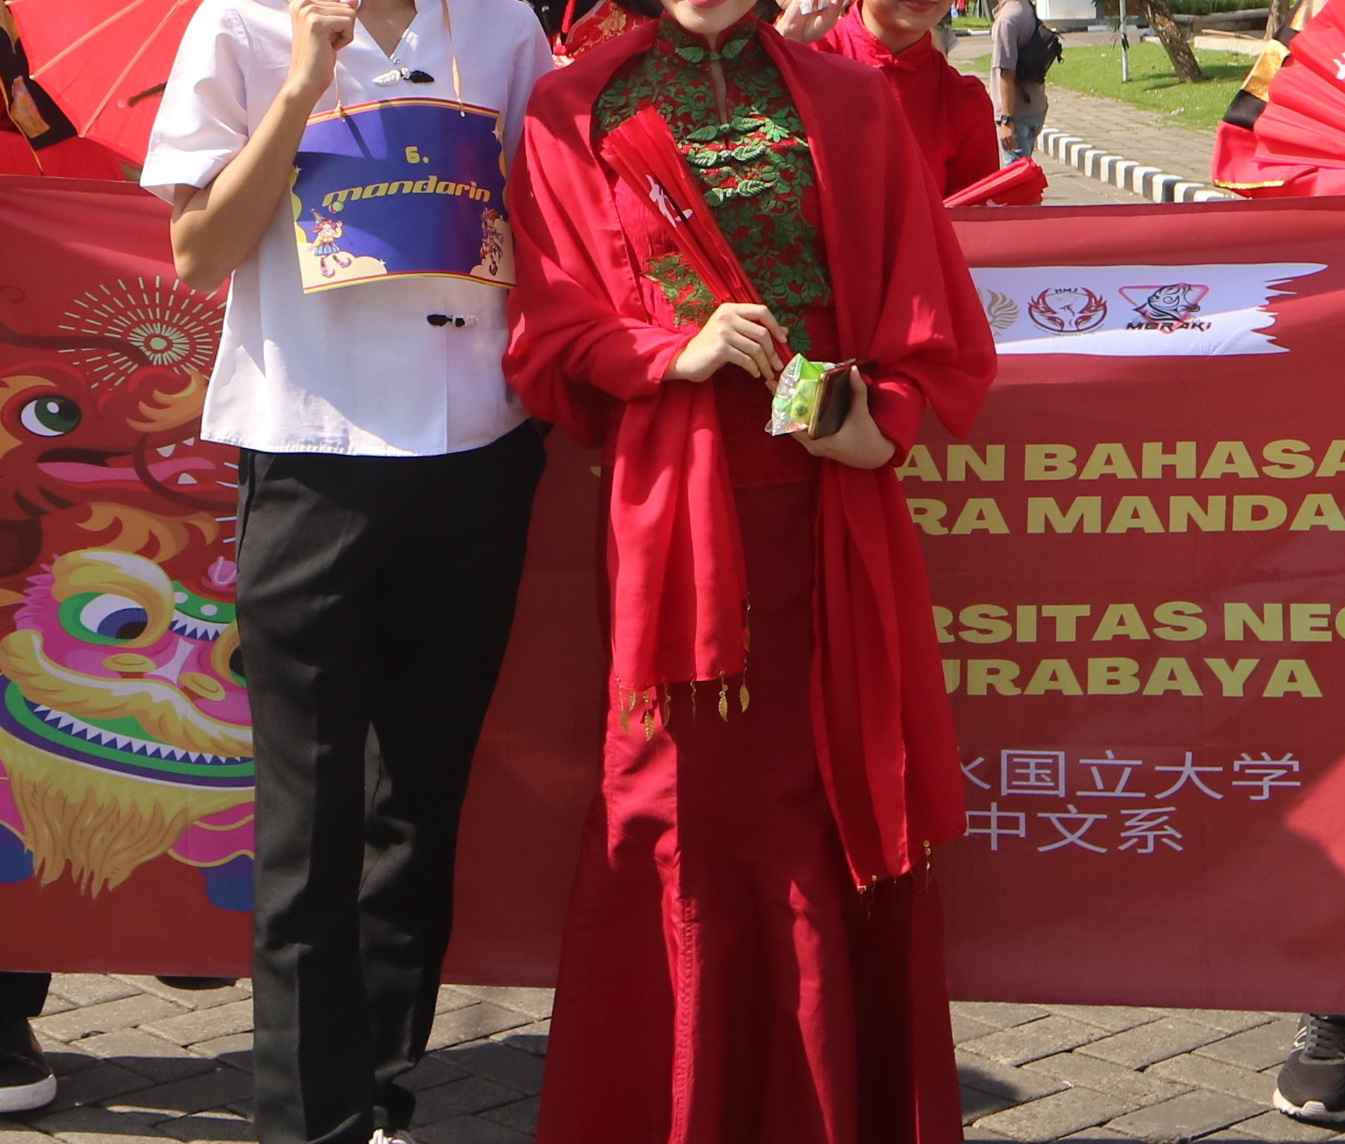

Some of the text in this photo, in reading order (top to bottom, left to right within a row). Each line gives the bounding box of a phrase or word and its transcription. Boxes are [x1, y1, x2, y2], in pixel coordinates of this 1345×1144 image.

[405, 146, 430, 164] 6.
[322, 175, 491, 208] mandarin
[895, 444, 1006, 482] AN
[906, 496, 1010, 536] RA
[964, 801, 1186, 855] 中文系
